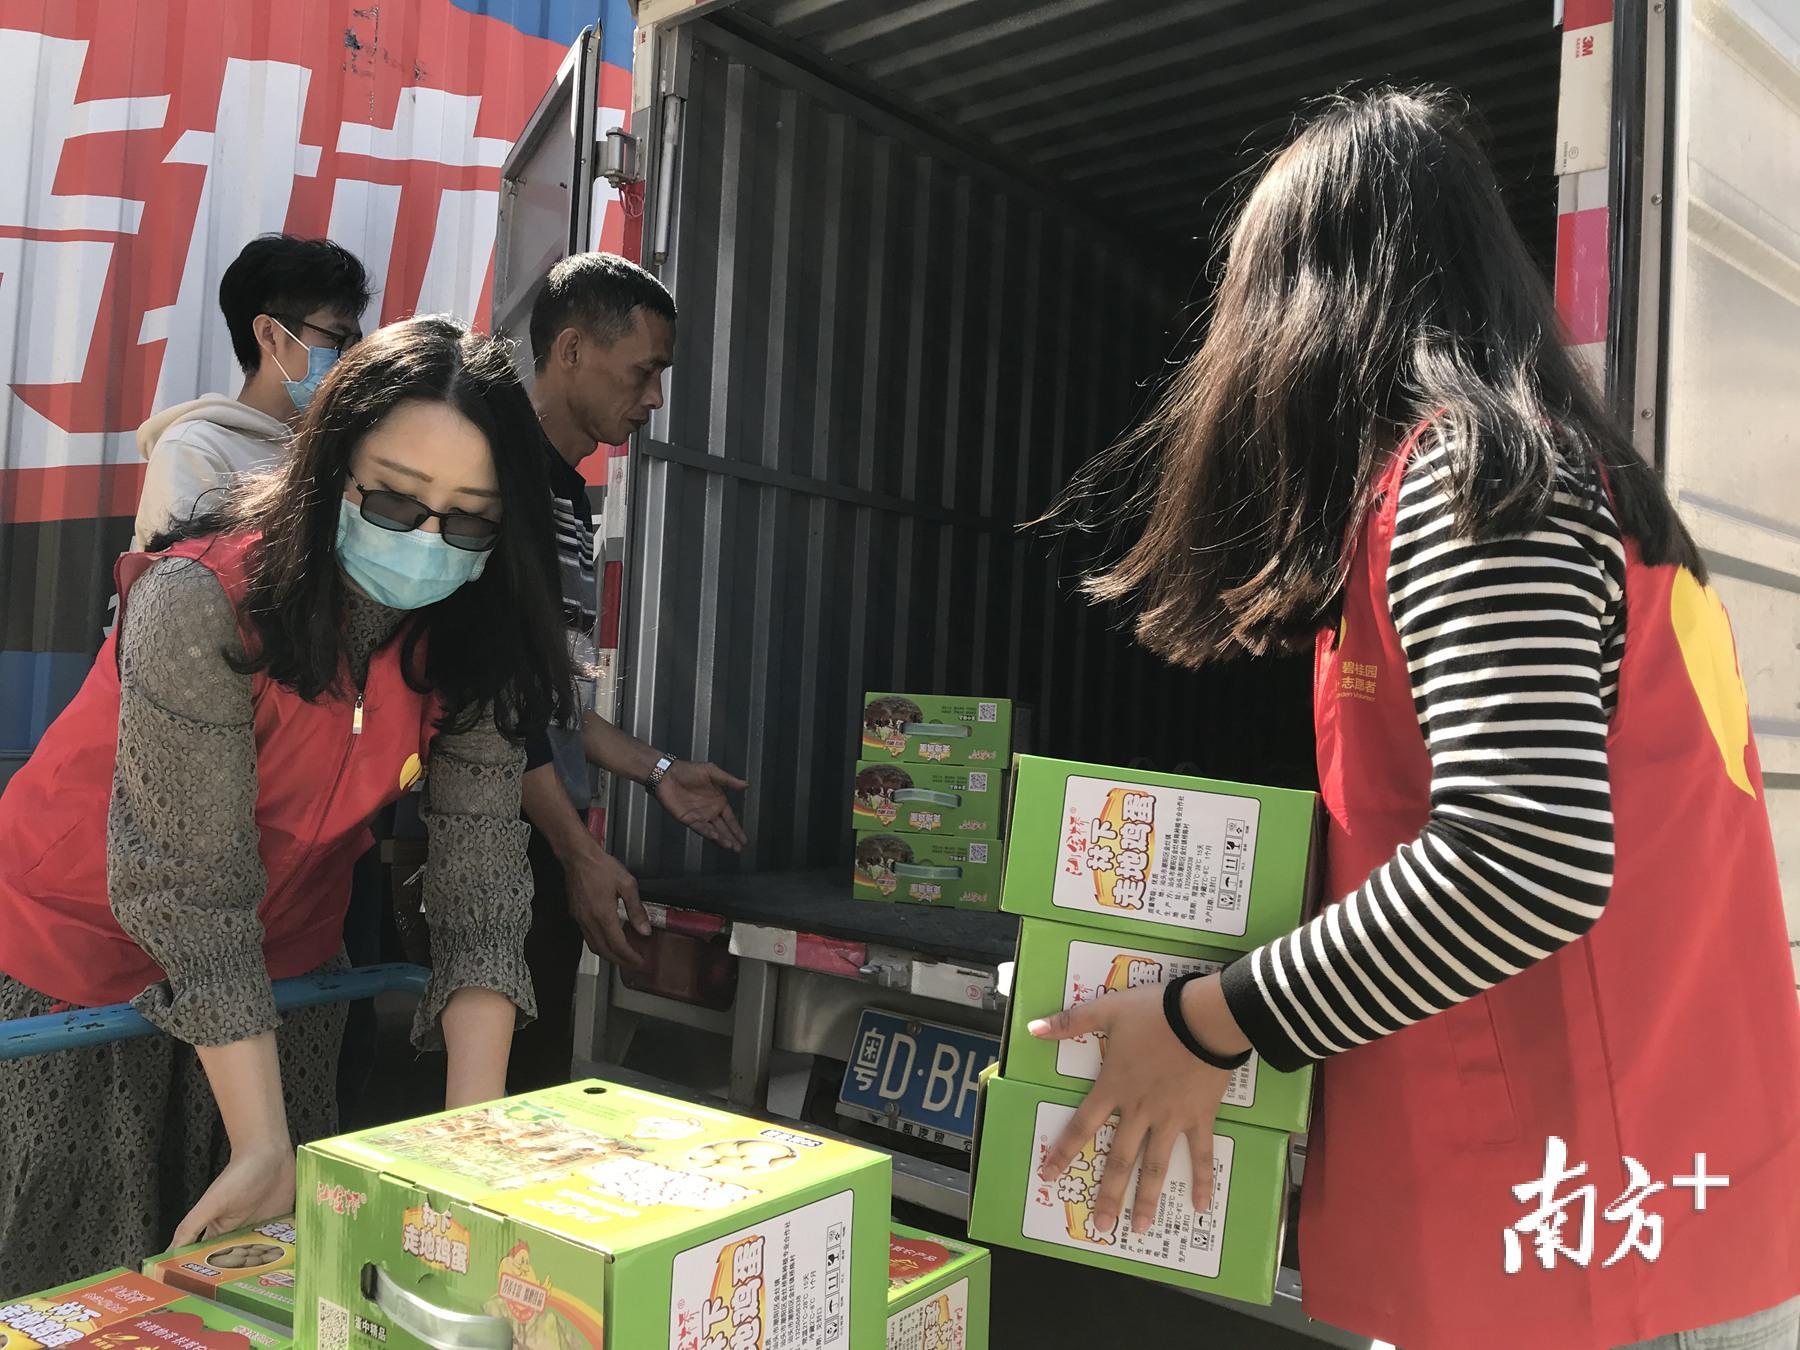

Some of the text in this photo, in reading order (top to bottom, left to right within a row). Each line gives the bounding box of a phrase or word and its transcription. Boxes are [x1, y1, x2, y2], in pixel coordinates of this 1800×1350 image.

[1582, 35, 1594, 57] 3M
[1342, 661, 1378, 678] 碧桂园
[1086, 816, 1118, 873] 林下
[1111, 793, 1157, 911] 走地鸡蛋
[403, 1222, 469, 1276] 走地鸡蛋
[354, 1314, 387, 1342] 蛋中精品
